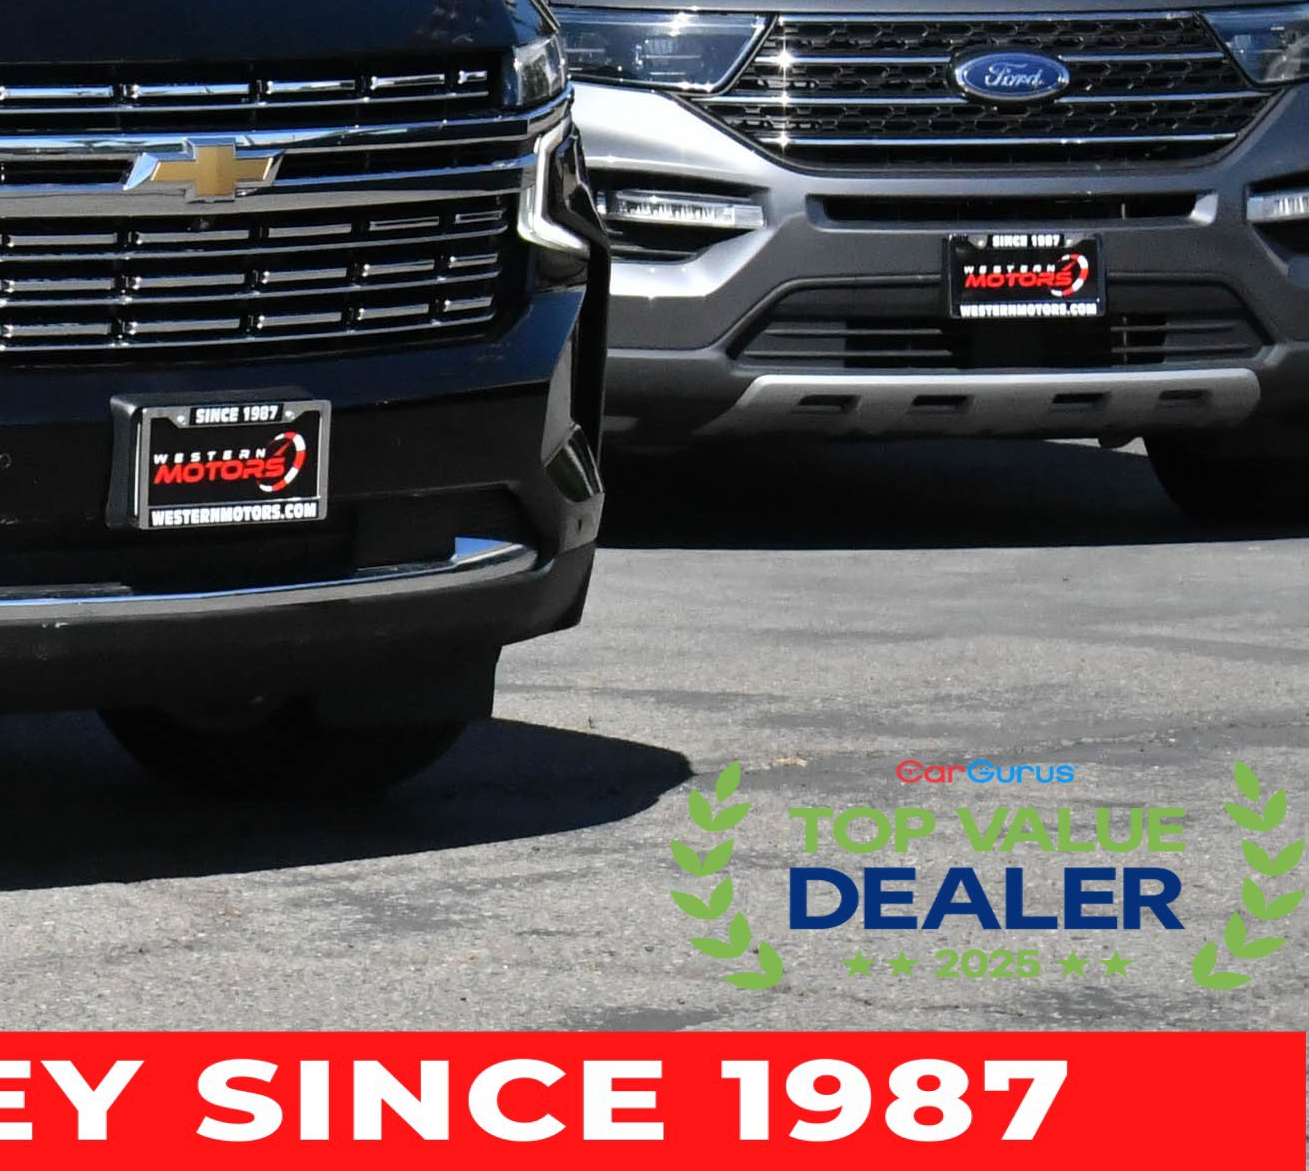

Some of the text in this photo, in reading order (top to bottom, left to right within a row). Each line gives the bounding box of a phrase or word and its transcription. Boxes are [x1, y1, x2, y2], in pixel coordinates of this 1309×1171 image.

[984, 61, 1045, 89] Ford
[964, 271, 1073, 288] MOTORS
[960, 303, 1097, 317] WESTERNMOTORS.COM
[195, 405, 278, 424] SINCE 1987
[153, 447, 267, 465] WESTERN
[153, 456, 285, 485] MOTORS
[151, 503, 317, 527] WESTERNMOTORS.COM
